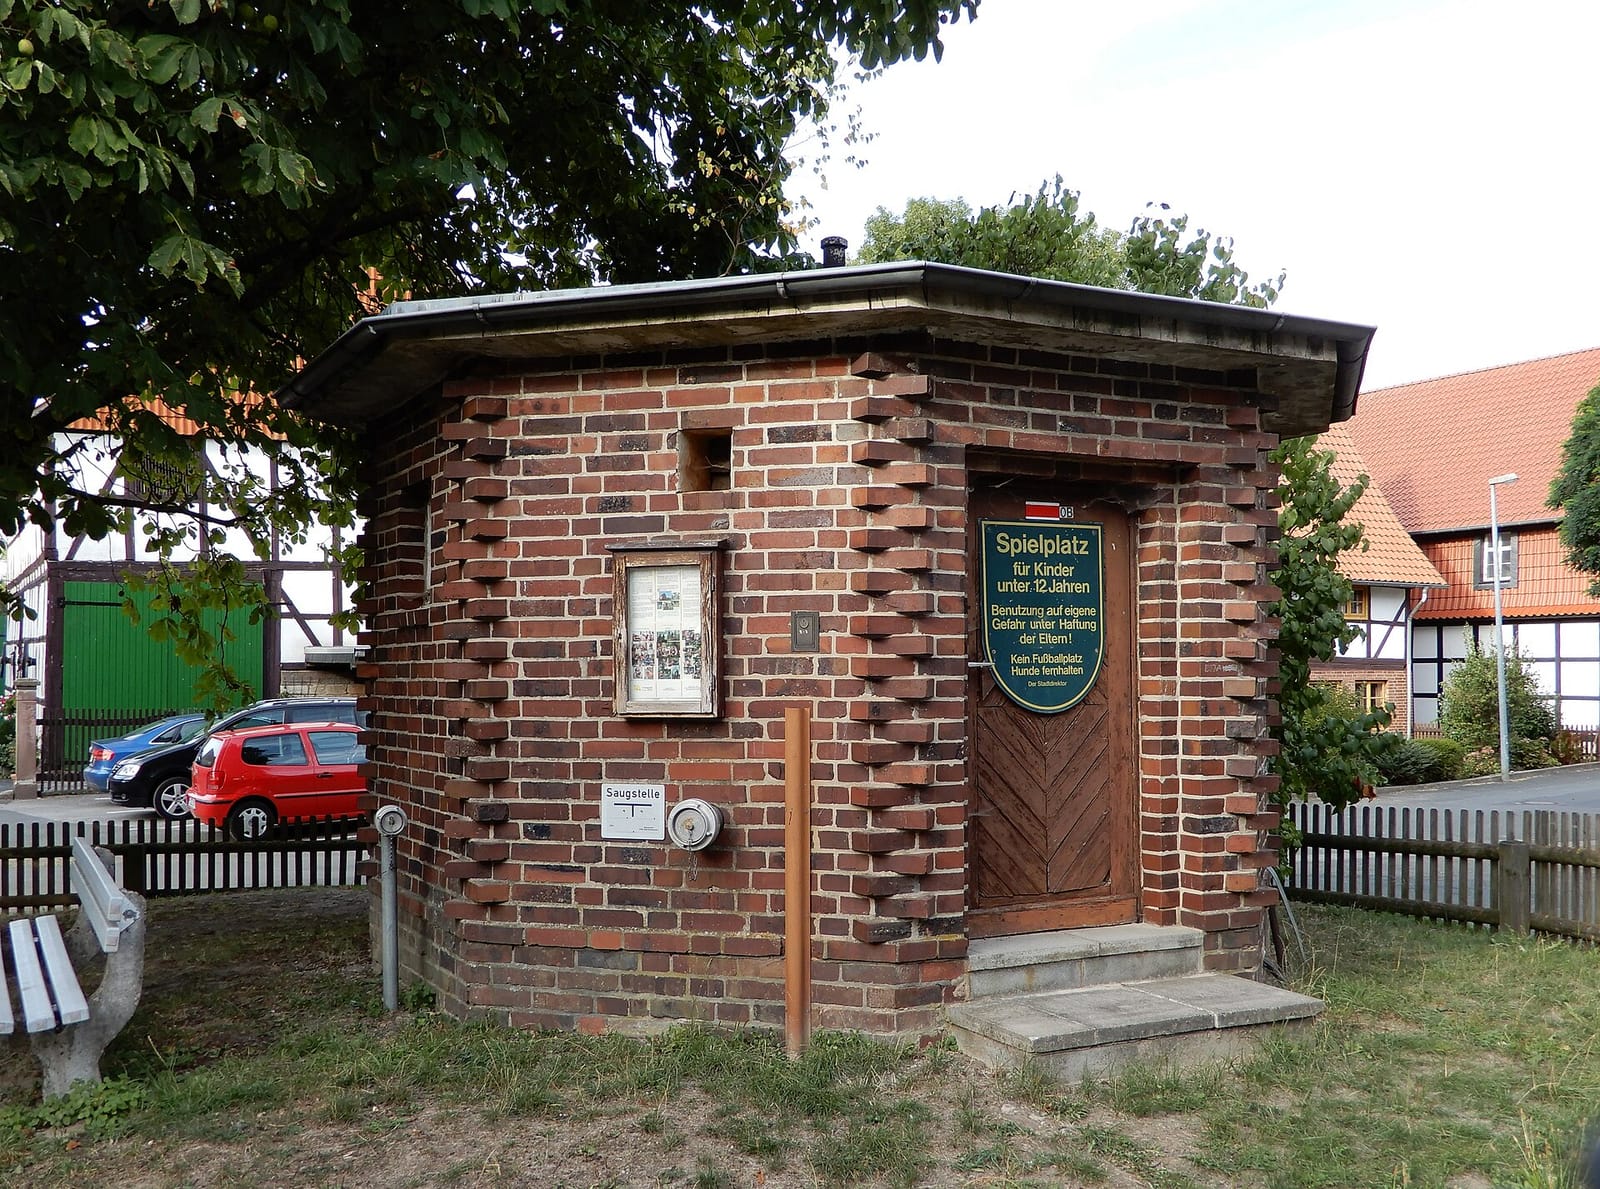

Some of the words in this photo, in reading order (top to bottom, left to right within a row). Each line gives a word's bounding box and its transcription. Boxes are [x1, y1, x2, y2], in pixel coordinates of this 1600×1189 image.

[996, 532, 1089, 558] Spielplatz
[1013, 561, 1031, 576] für
[1034, 562, 1075, 577] Kinder
[997, 579, 1031, 592] unter
[1033, 579, 1048, 593] 12
[1048, 579, 1090, 593] Jahren
[991, 604, 1044, 618] Benutzung
[1046, 605, 1063, 616] auf
[1064, 605, 1097, 618] eigene
[992, 618, 1026, 630] Gefahr
[1030, 619, 1056, 630] unter
[1059, 619, 1097, 632] Haftung
[1019, 633, 1037, 644] der
[1010, 654, 1030, 664] Kein
[1032, 654, 1083, 665] Fußballplatz
[1011, 666, 1040, 676] Hunde
[1042, 666, 1084, 676] fernhalten
[606, 788, 660, 800] Saugstelle
